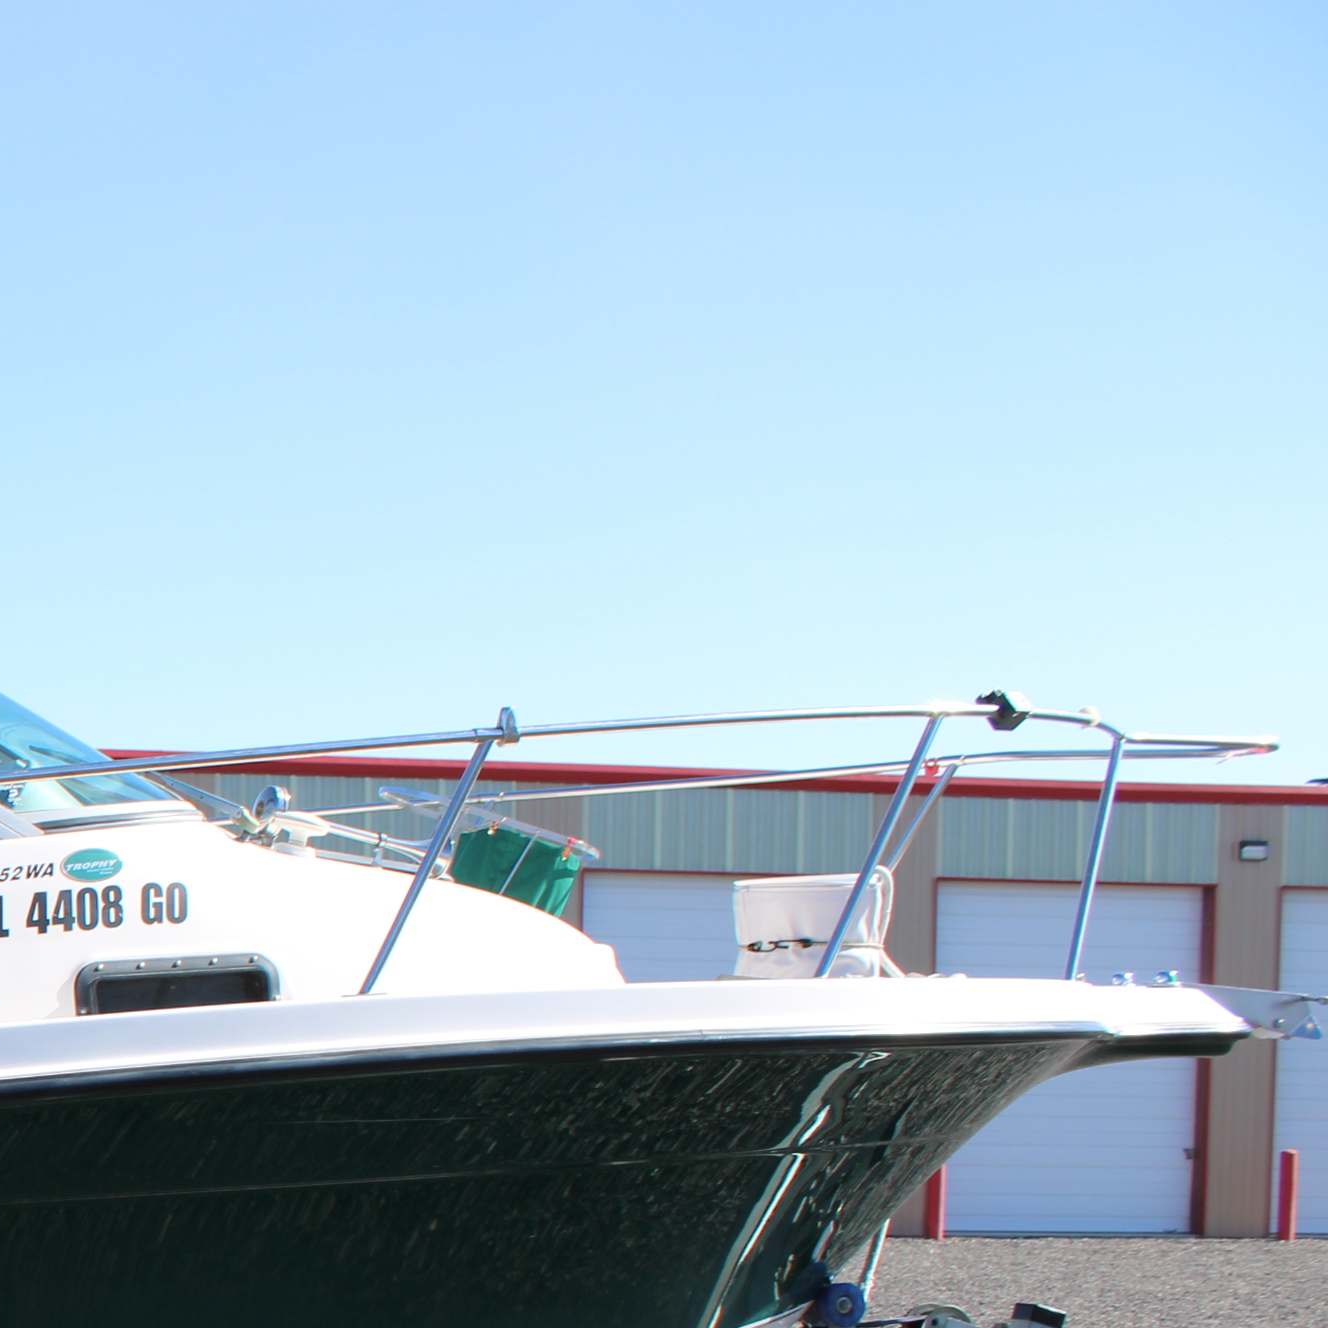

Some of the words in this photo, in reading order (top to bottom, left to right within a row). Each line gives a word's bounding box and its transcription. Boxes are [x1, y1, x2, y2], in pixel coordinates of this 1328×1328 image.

[65, 859, 118, 872] TROPHY
[26, 885, 124, 935] 4408
[141, 881, 188, 925] GO
